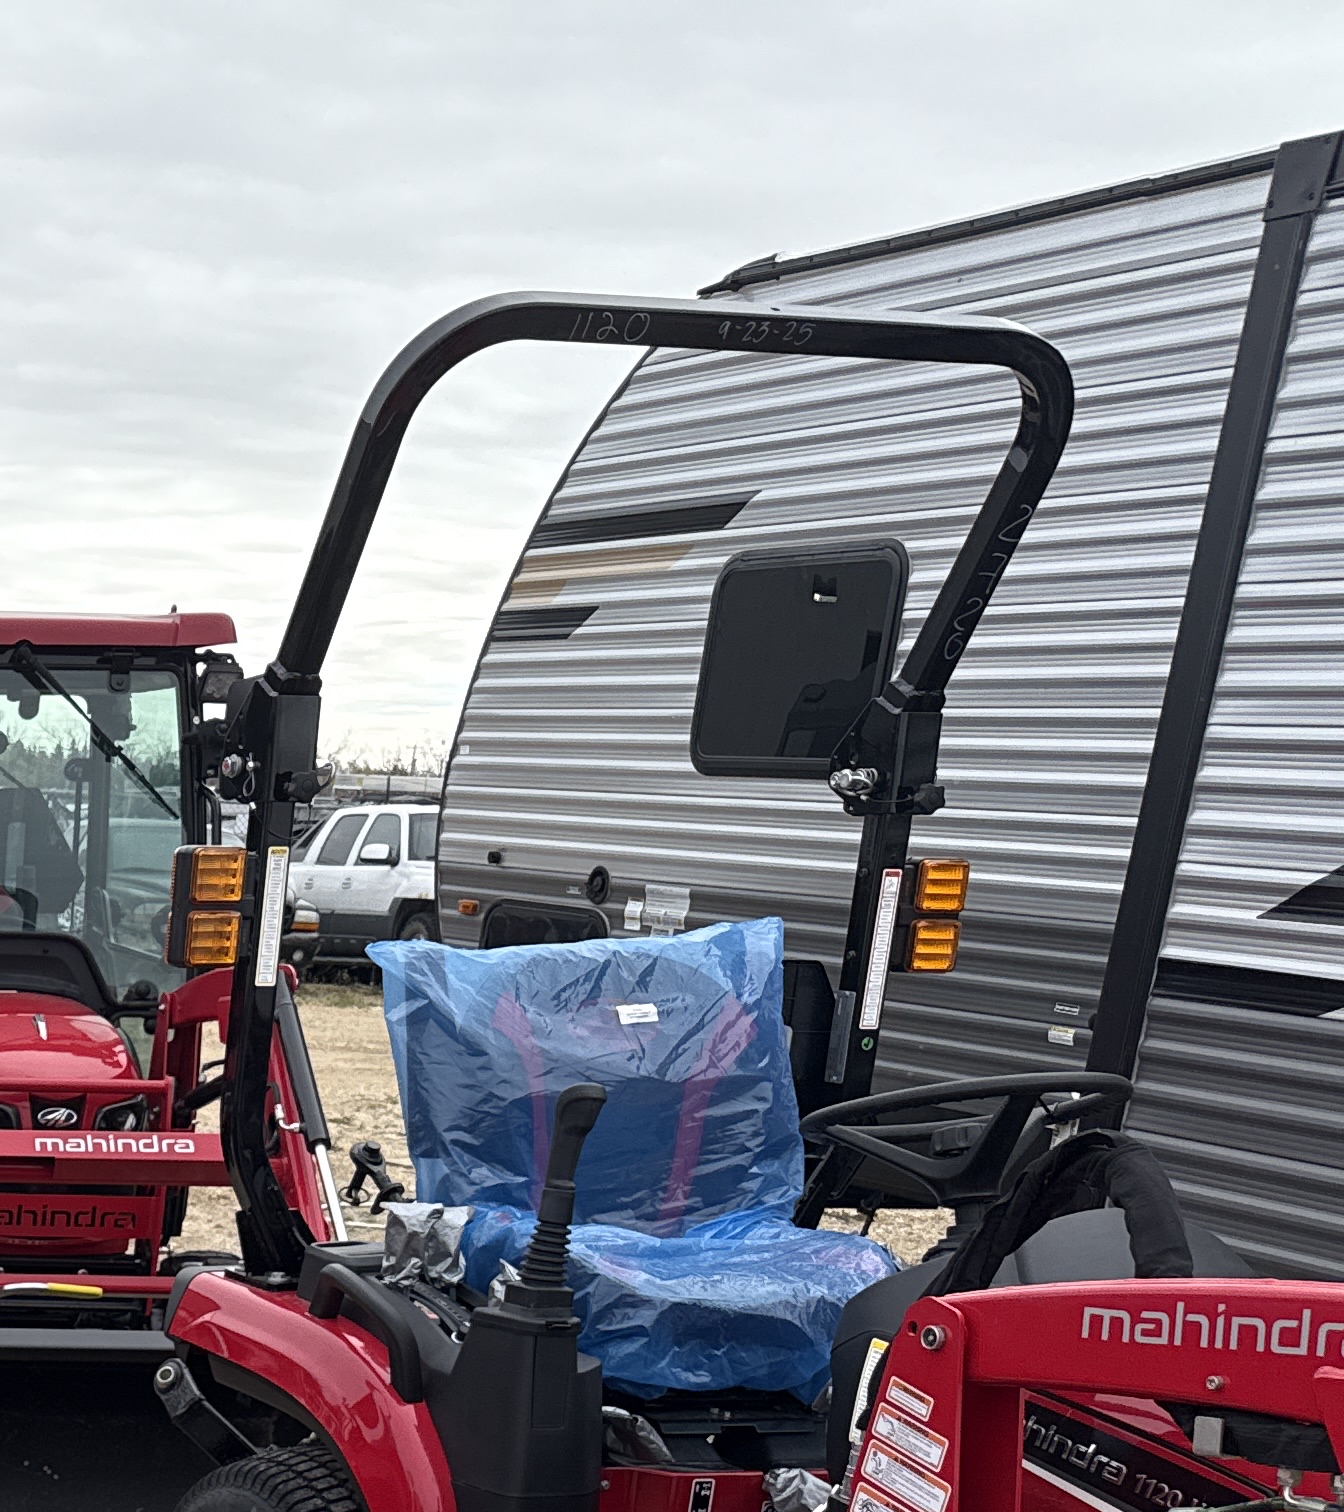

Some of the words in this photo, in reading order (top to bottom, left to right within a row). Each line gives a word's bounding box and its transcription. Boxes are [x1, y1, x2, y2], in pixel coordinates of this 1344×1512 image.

[569, 312, 651, 342] 1120
[718, 320, 817, 346] 9-23-25
[34, 1133, 196, 1154] mahindra
[1080, 1301, 1344, 1358] mahindr
[1023, 1415, 1128, 1486] hindra
[1134, 1473, 1183, 1509] 1120
